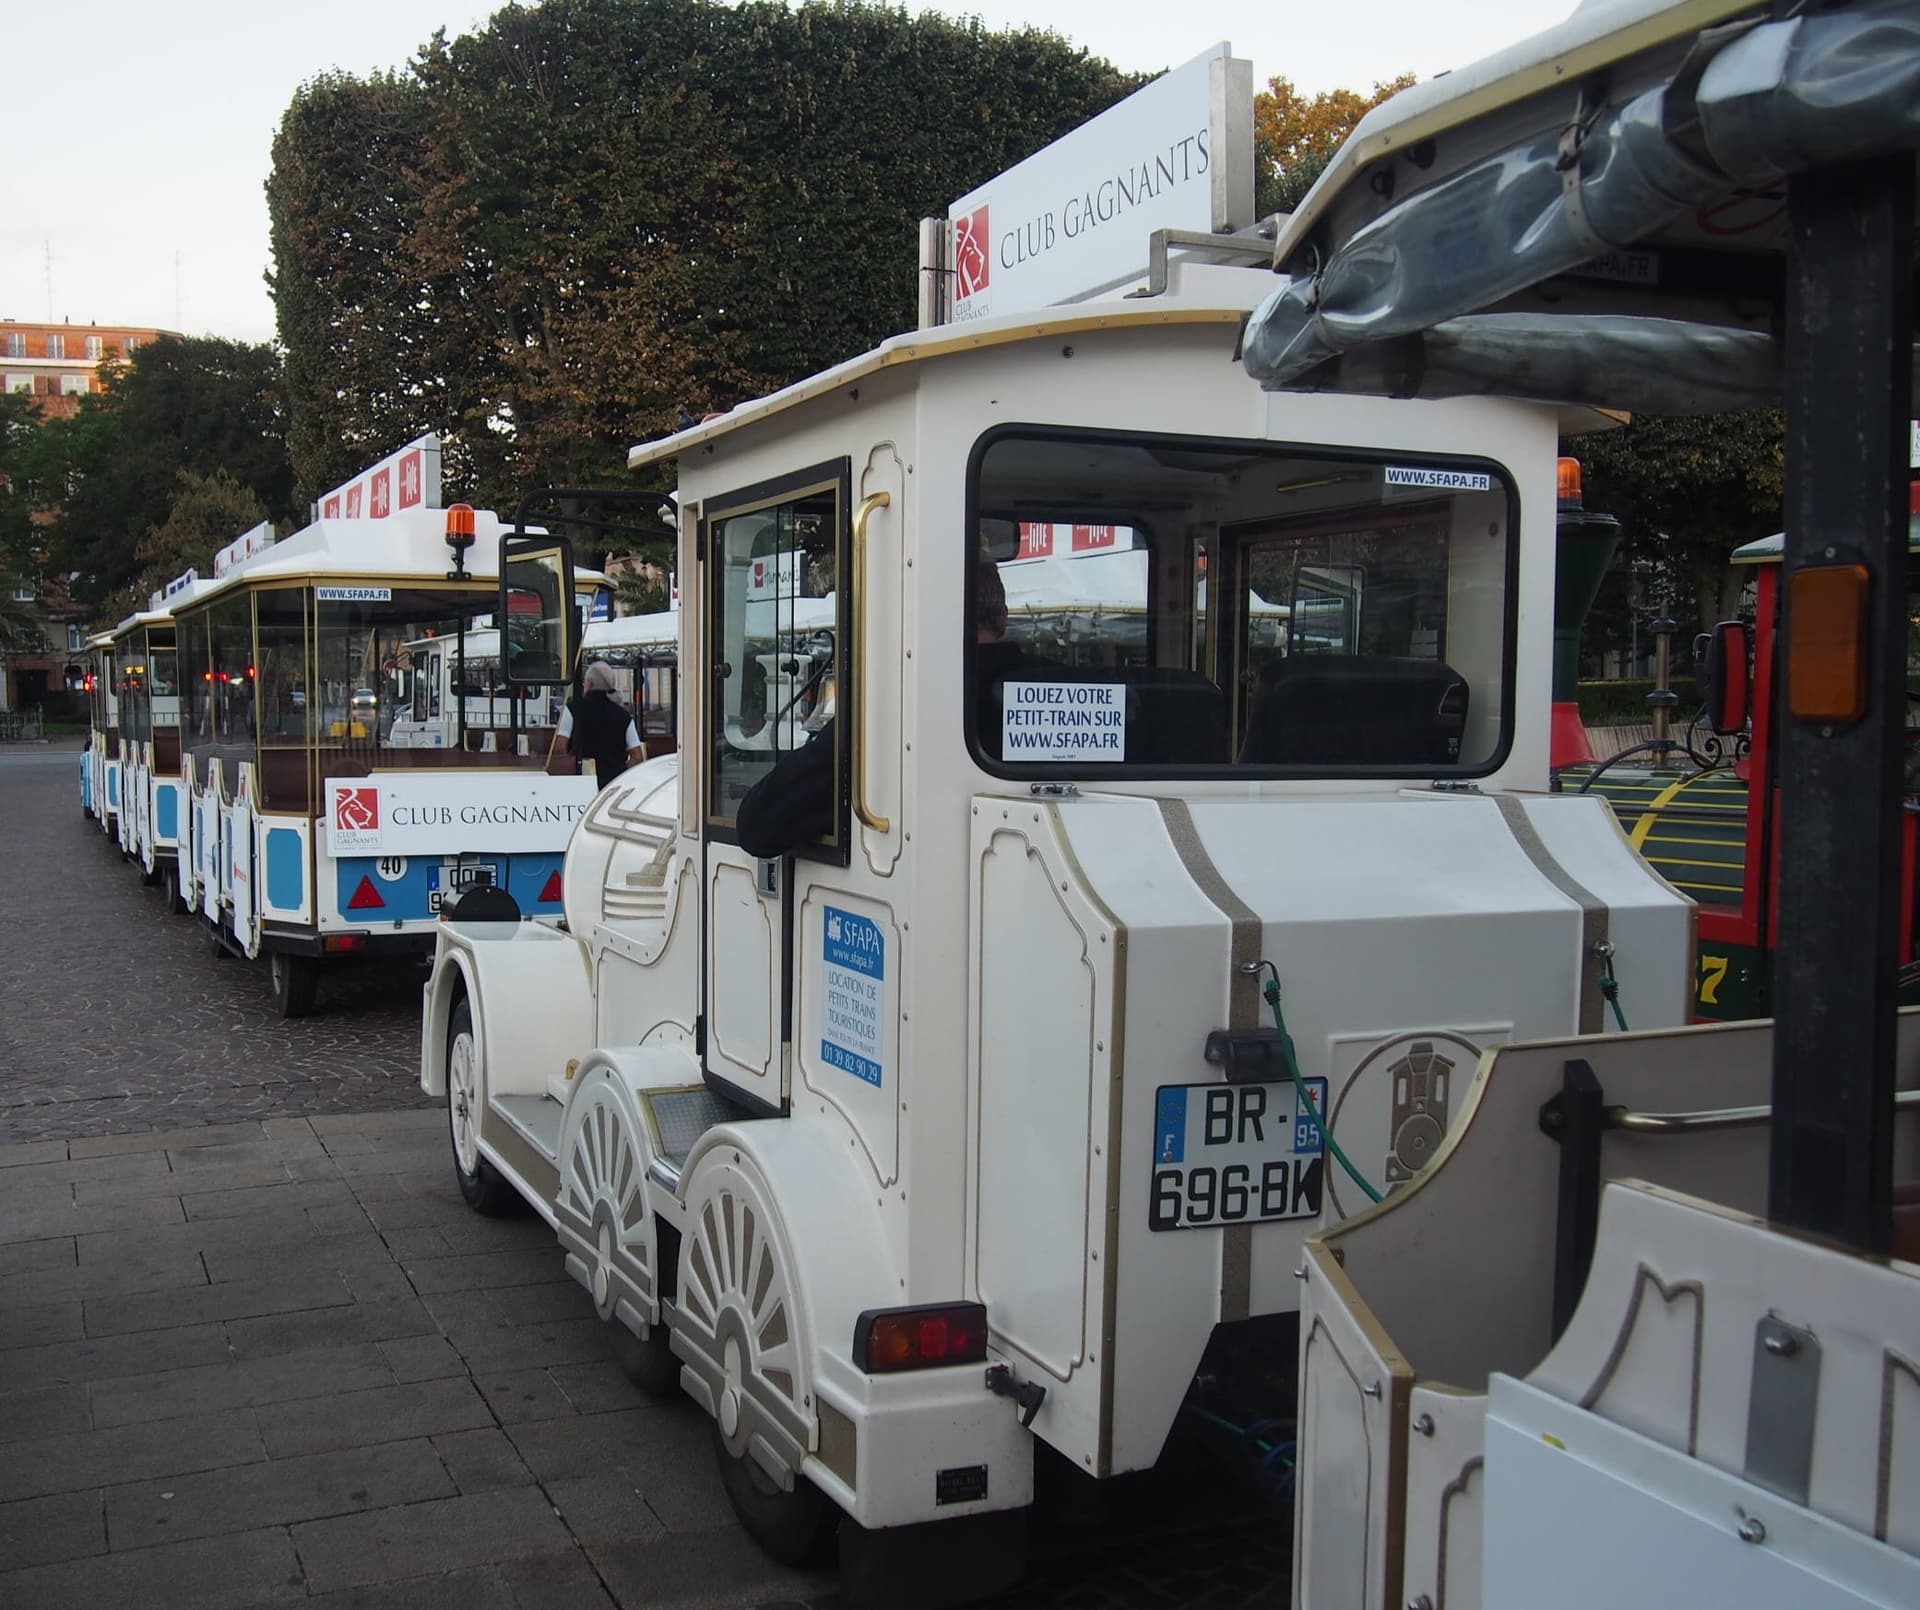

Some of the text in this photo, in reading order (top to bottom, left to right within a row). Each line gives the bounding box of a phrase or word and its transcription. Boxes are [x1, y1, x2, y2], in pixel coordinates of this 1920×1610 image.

[1000, 128, 1210, 269] CLUB GAGNANTS
[1387, 469, 1488, 489] WWW.SFAPA.FR
[319, 588, 390, 600] WWW.SFAPA.FR
[1016, 687, 1113, 705] LOUEZ VOTRE
[1006, 709, 1122, 727] PETIT-TRAIN SUR
[1008, 732, 1120, 749] WWW.SFAPA.FR
[392, 803, 588, 826] CLUB GAGNANTS
[381, 856, 401, 875] 40
[844, 919, 881, 955] SFAPA
[832, 947, 874, 970] www.sfapa.fr
[829, 968, 876, 1000] LOCATION DE
[828, 990, 876, 1020] PETITS TRAINS
[828, 1008, 876, 1041] TOURISTIQUES
[824, 1044, 878, 1083] 01 39 82 90 29
[1165, 1134, 1175, 1151] F
[1296, 1123, 1320, 1147] 95
[1152, 1157, 1322, 1226] 696-BK
